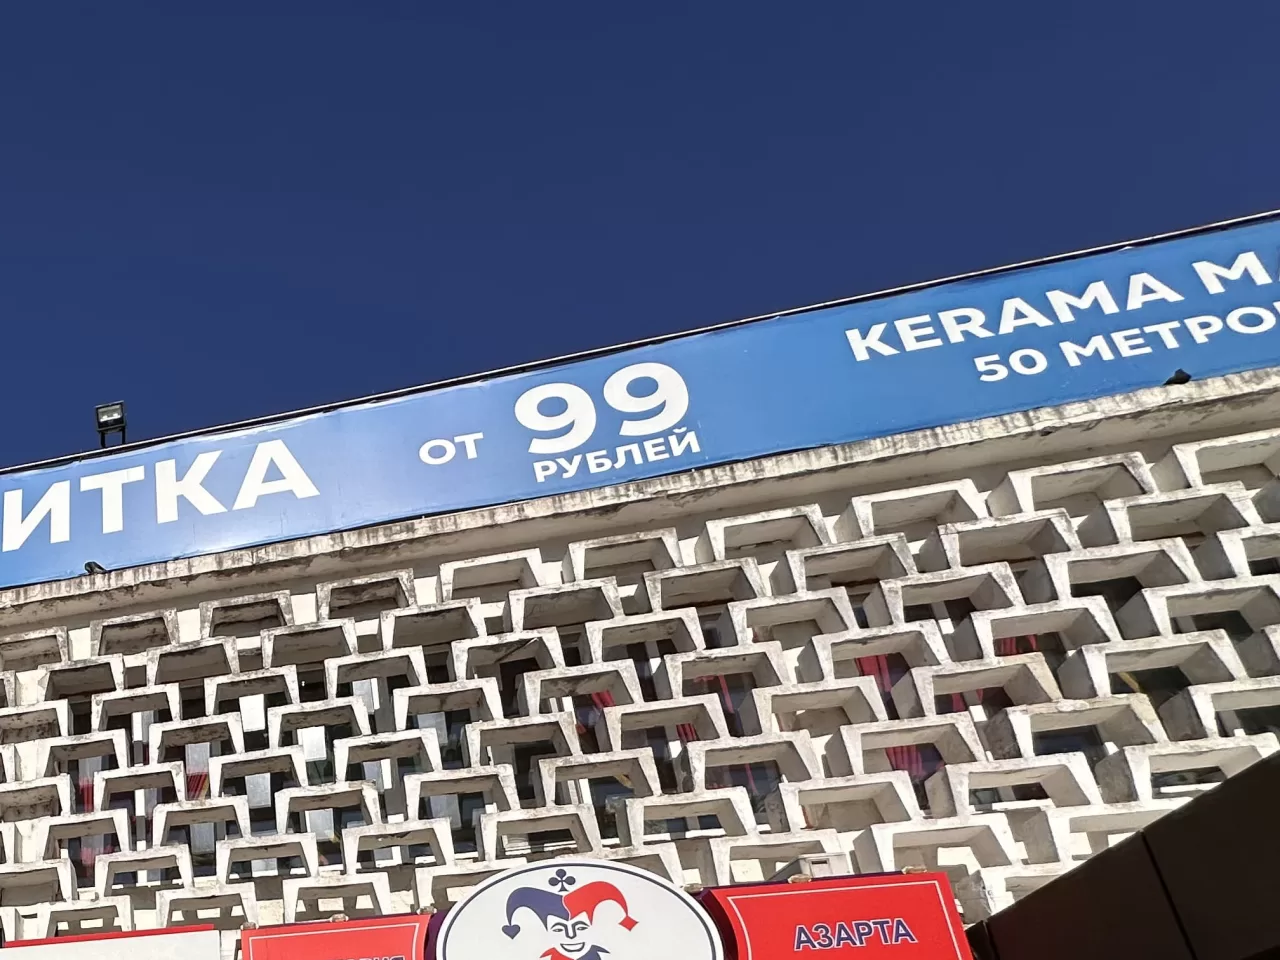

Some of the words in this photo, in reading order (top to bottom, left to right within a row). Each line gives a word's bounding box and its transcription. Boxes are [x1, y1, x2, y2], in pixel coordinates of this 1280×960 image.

[845, 271, 1185, 362] KERAMA
[1191, 251, 1280, 294] M
[973, 349, 1048, 383] 50
[1059, 301, 1280, 368] МЕТРО
[515, 362, 689, 454] 99
[533, 426, 701, 483] РУБЛЕЙ
[793, 916, 917, 952] АЗАРТА
